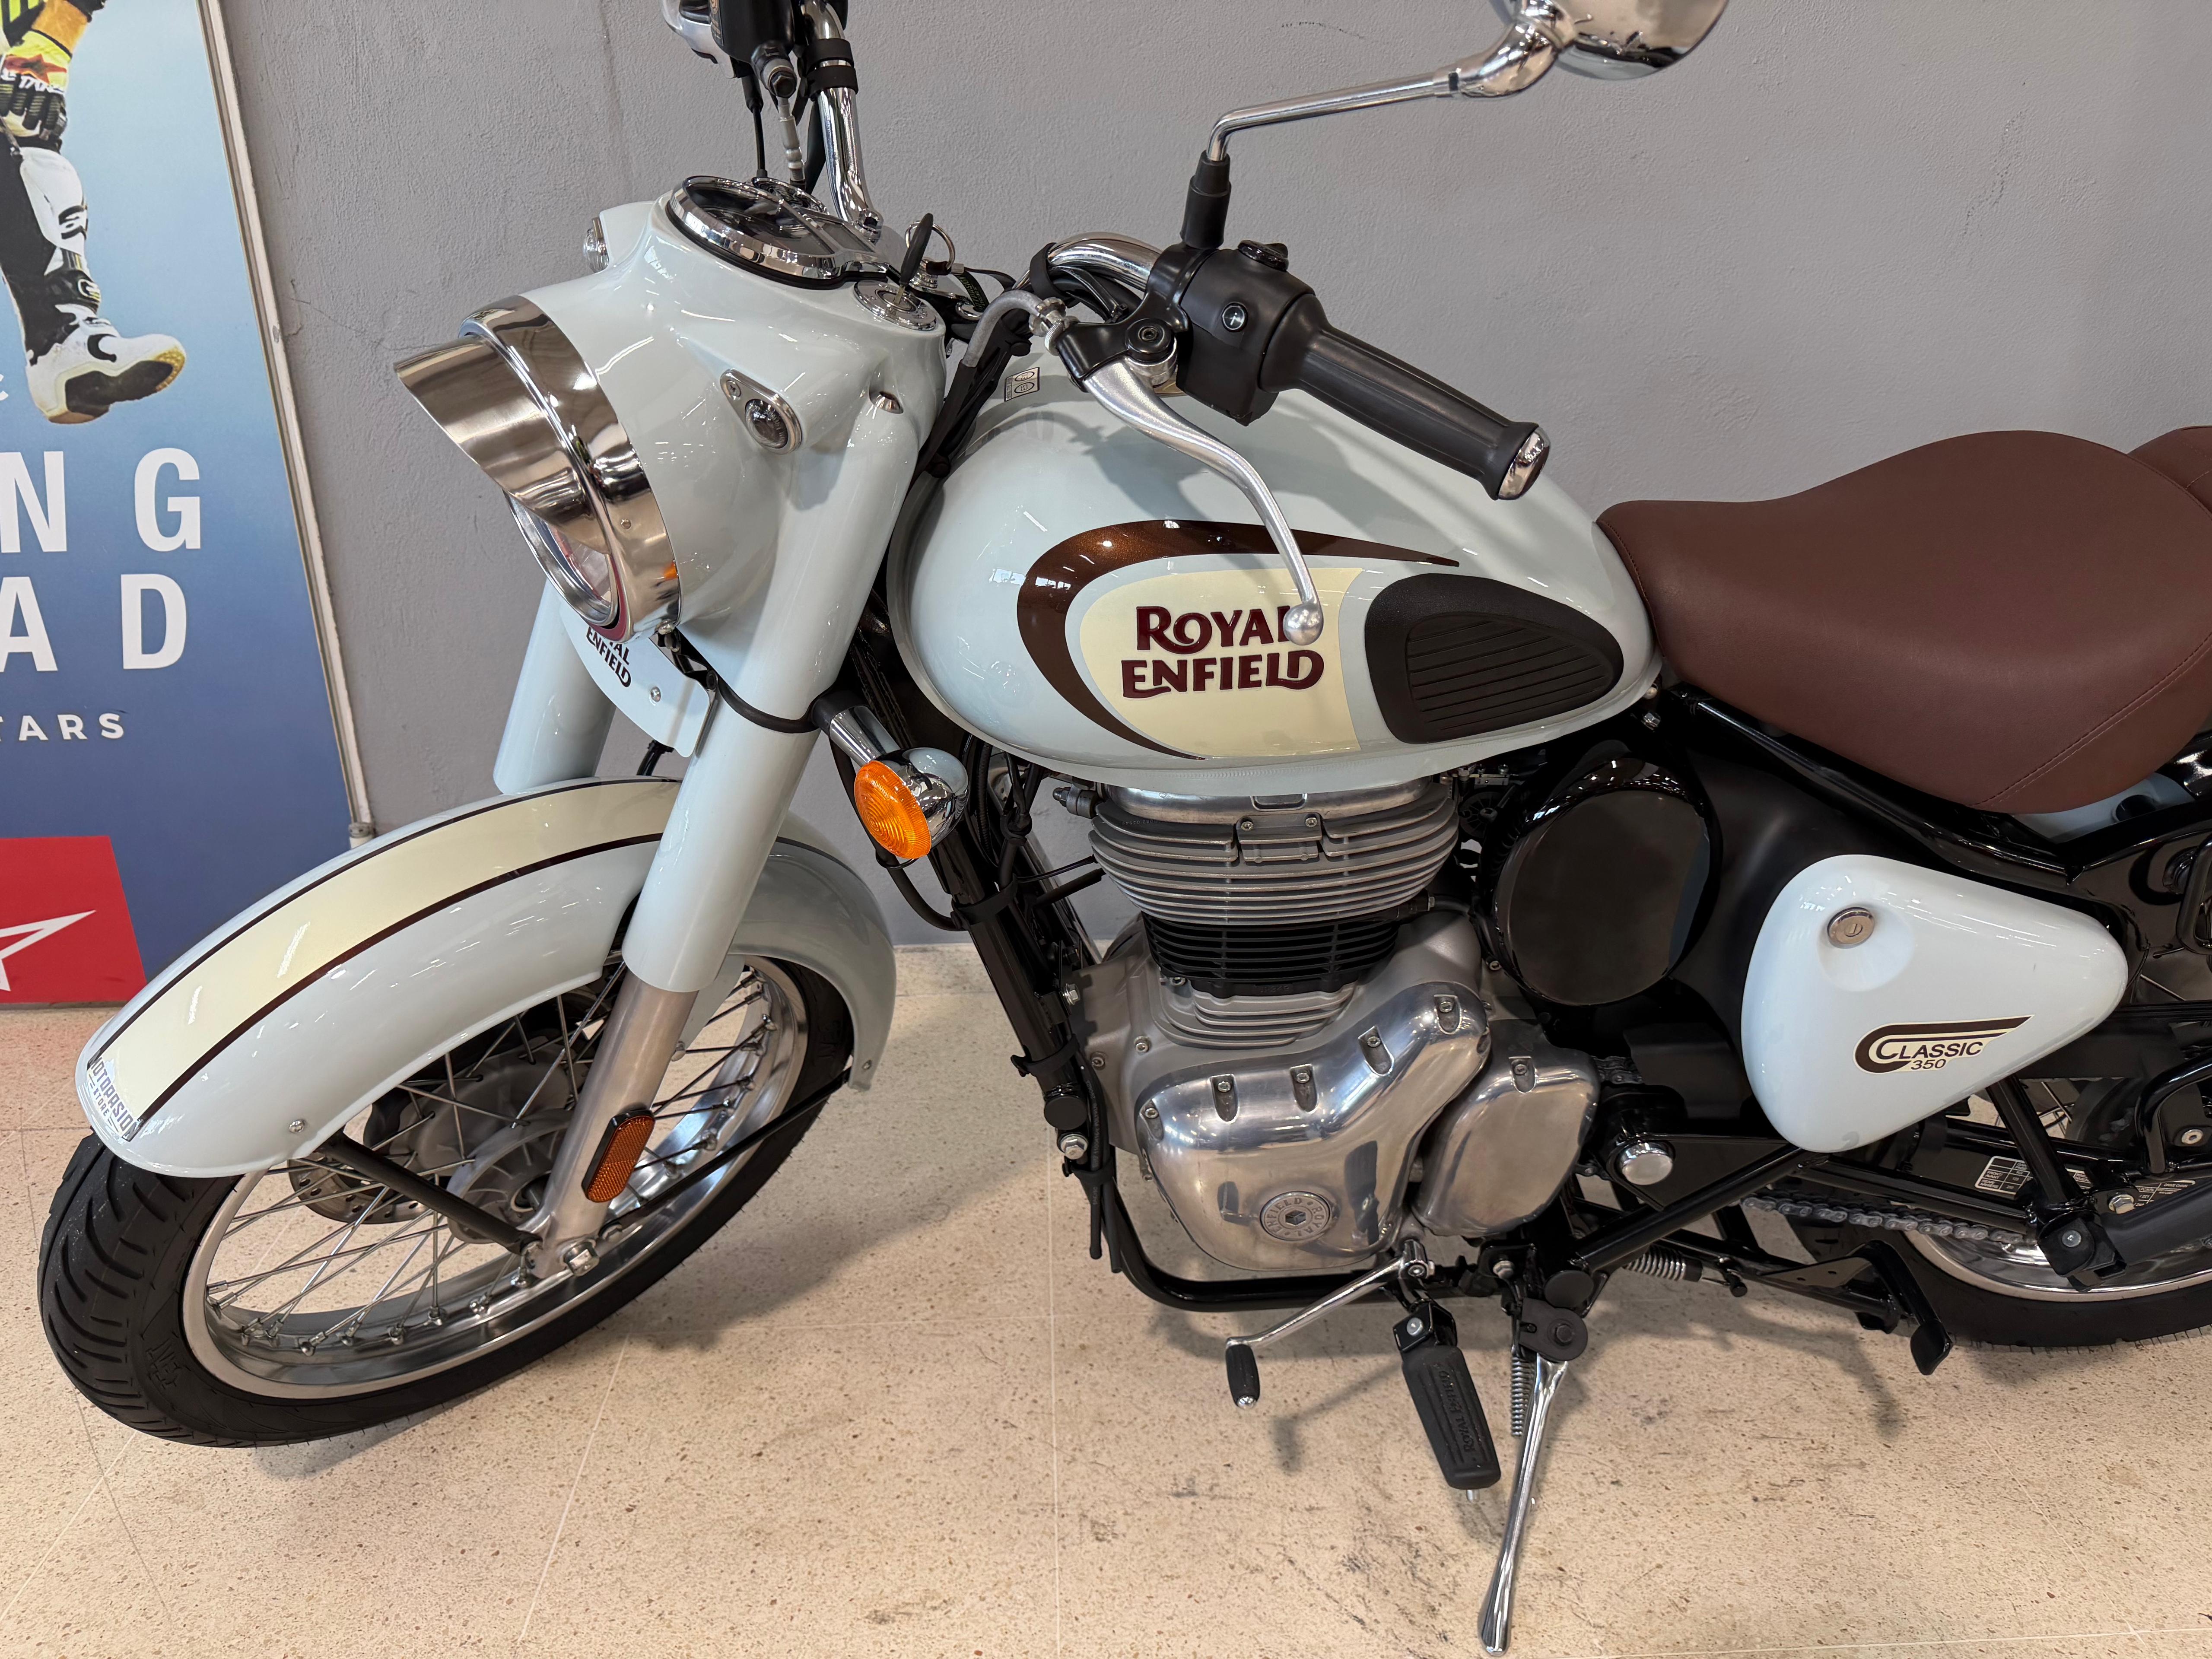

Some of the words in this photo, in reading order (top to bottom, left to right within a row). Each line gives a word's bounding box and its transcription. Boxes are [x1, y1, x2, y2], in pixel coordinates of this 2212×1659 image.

[586, 626, 631, 687] ENFIELD
[1121, 650, 1324, 699] ENFIELD
[0, 713, 124, 741] ARS
[1876, 1038, 1983, 1060] CLASSIC
[1910, 1059, 1946, 1071] 350
[1456, 1416, 1476, 1452] ROYAL
